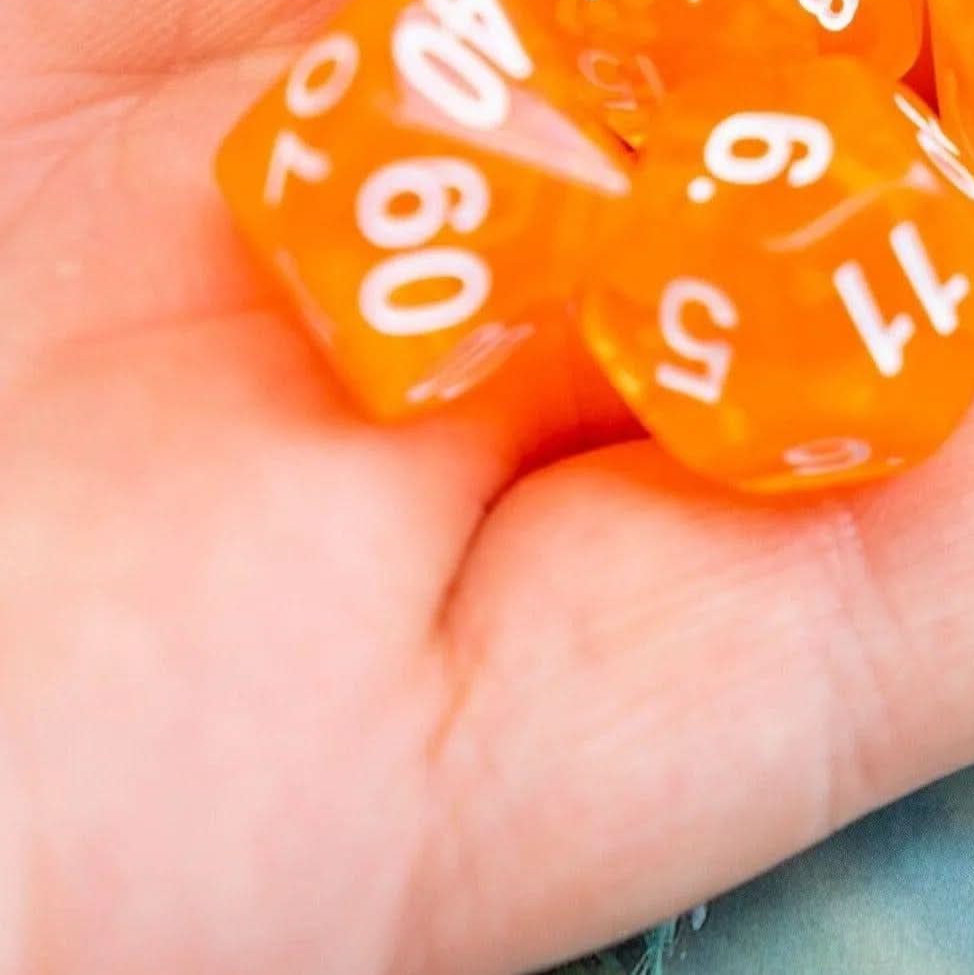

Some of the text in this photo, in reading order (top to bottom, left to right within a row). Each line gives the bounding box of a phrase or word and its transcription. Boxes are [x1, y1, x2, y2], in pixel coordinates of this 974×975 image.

[355, 156, 492, 337] 60
[832, 220, 971, 377] 11
[655, 276, 739, 405] 5
